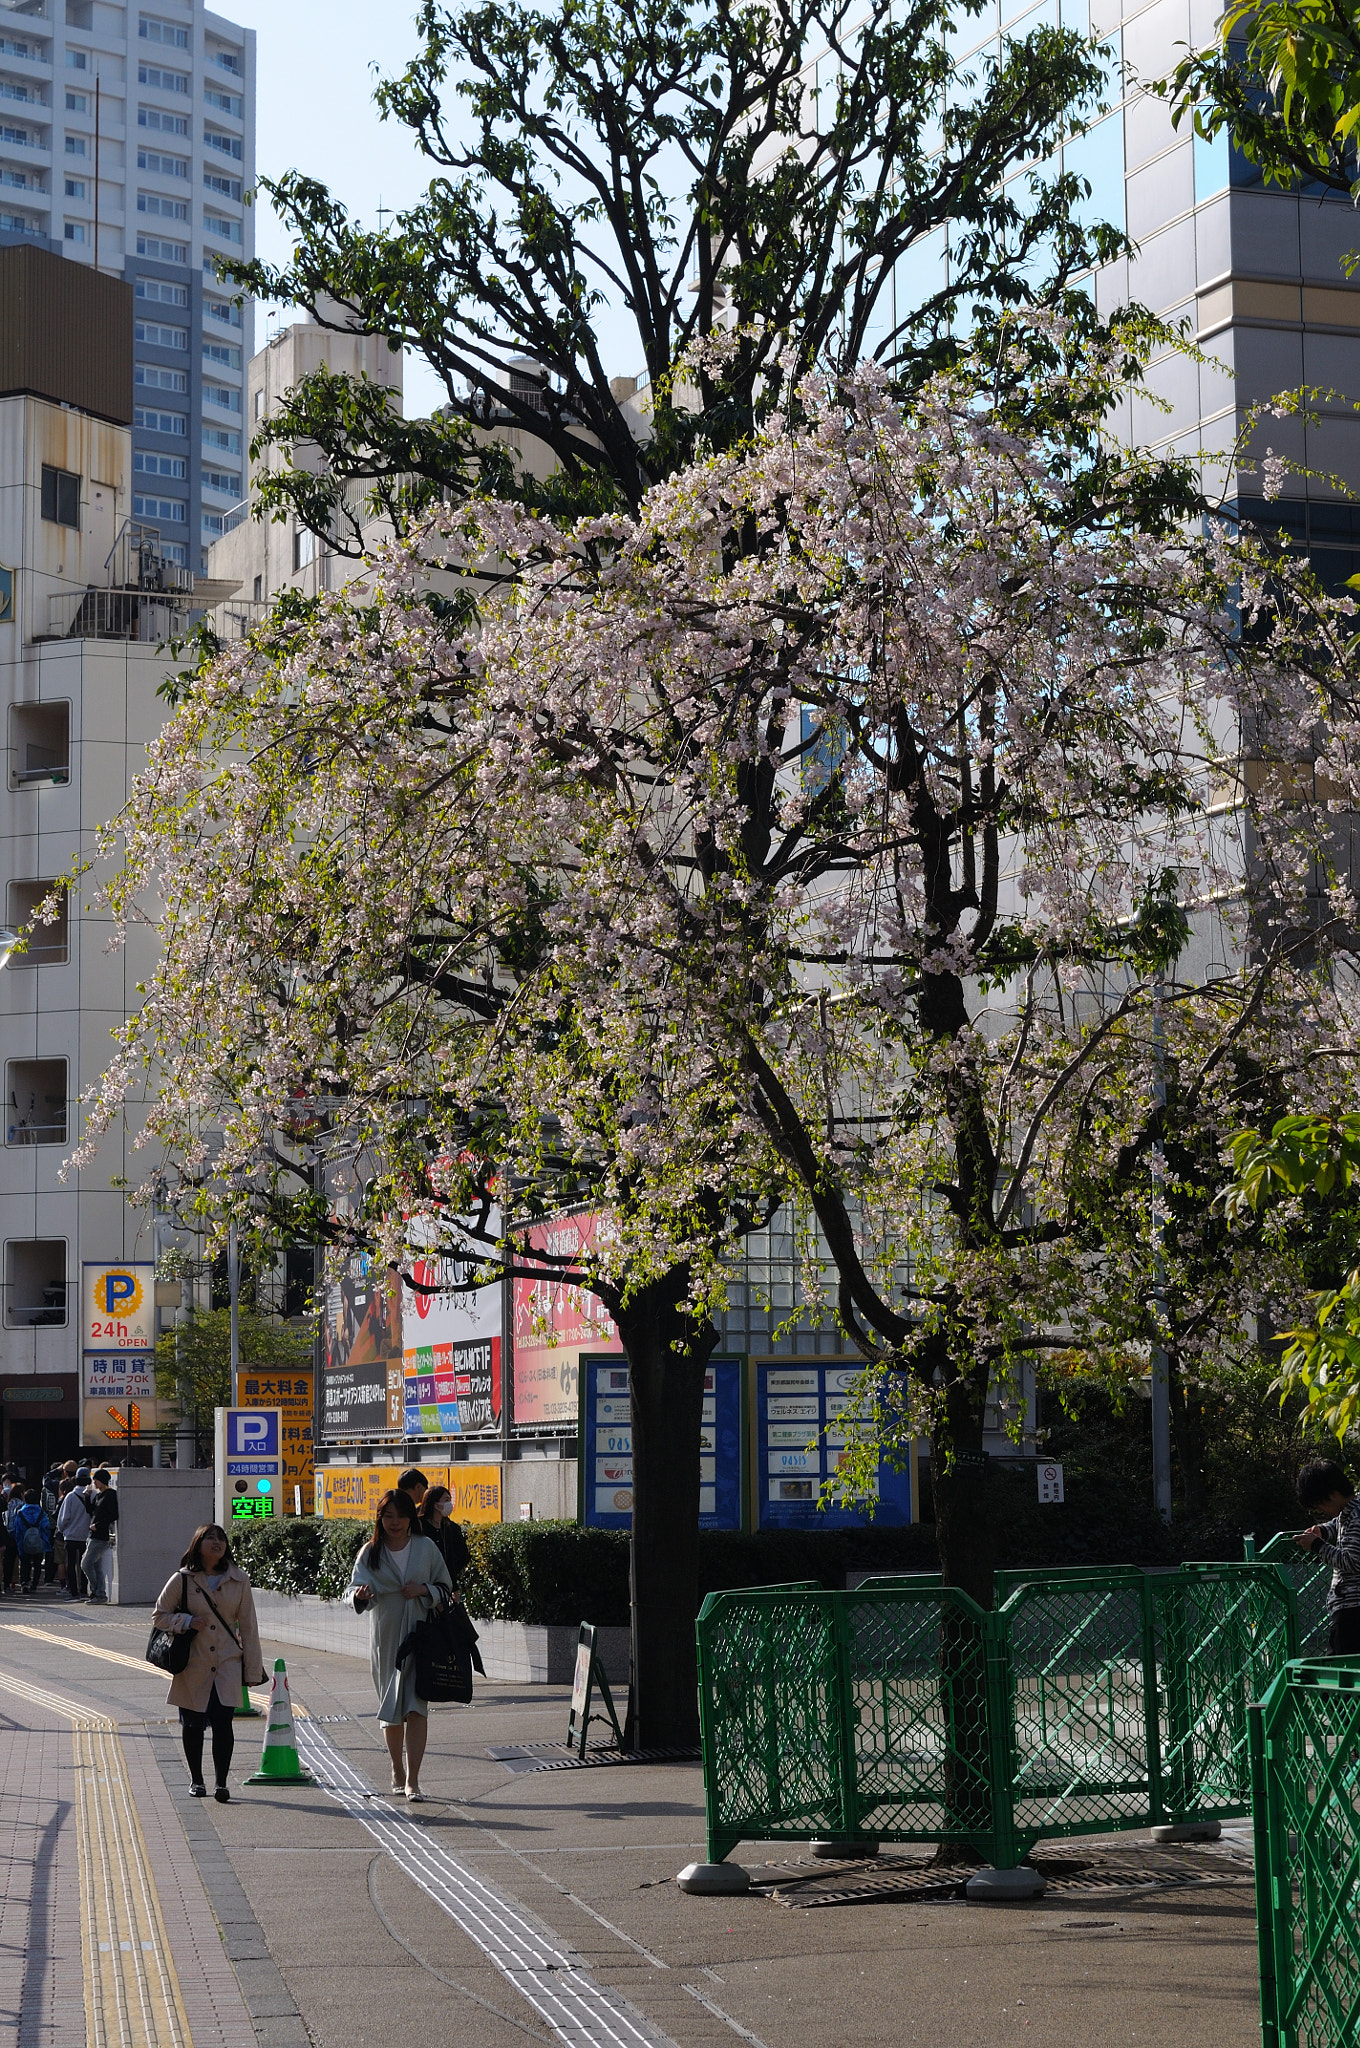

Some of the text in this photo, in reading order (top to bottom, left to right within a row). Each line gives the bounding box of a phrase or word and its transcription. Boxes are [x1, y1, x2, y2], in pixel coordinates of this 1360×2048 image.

[106, 1275, 135, 1313] P
[91, 1322, 128, 1338] 24h
[118, 1338, 148, 1347] OPEN
[93, 1359, 146, 1374] 時間貸
[89, 1375, 149, 1384] ハイルーフOK
[89, 1385, 150, 1396] 車高制限2.1m
[244, 1379, 309, 1396] 最大料金
[244, 1397, 309, 1407] 入庫から12時間以内
[391, 1395, 400, 1422] 5F
[236, 1415, 269, 1452] P
[247, 1441, 267, 1452] 入口
[230, 1463, 276, 1474] 24時間営業
[458, 1483, 499, 1510] ハイジア駐車場
[232, 1496, 274, 1520] 空車
